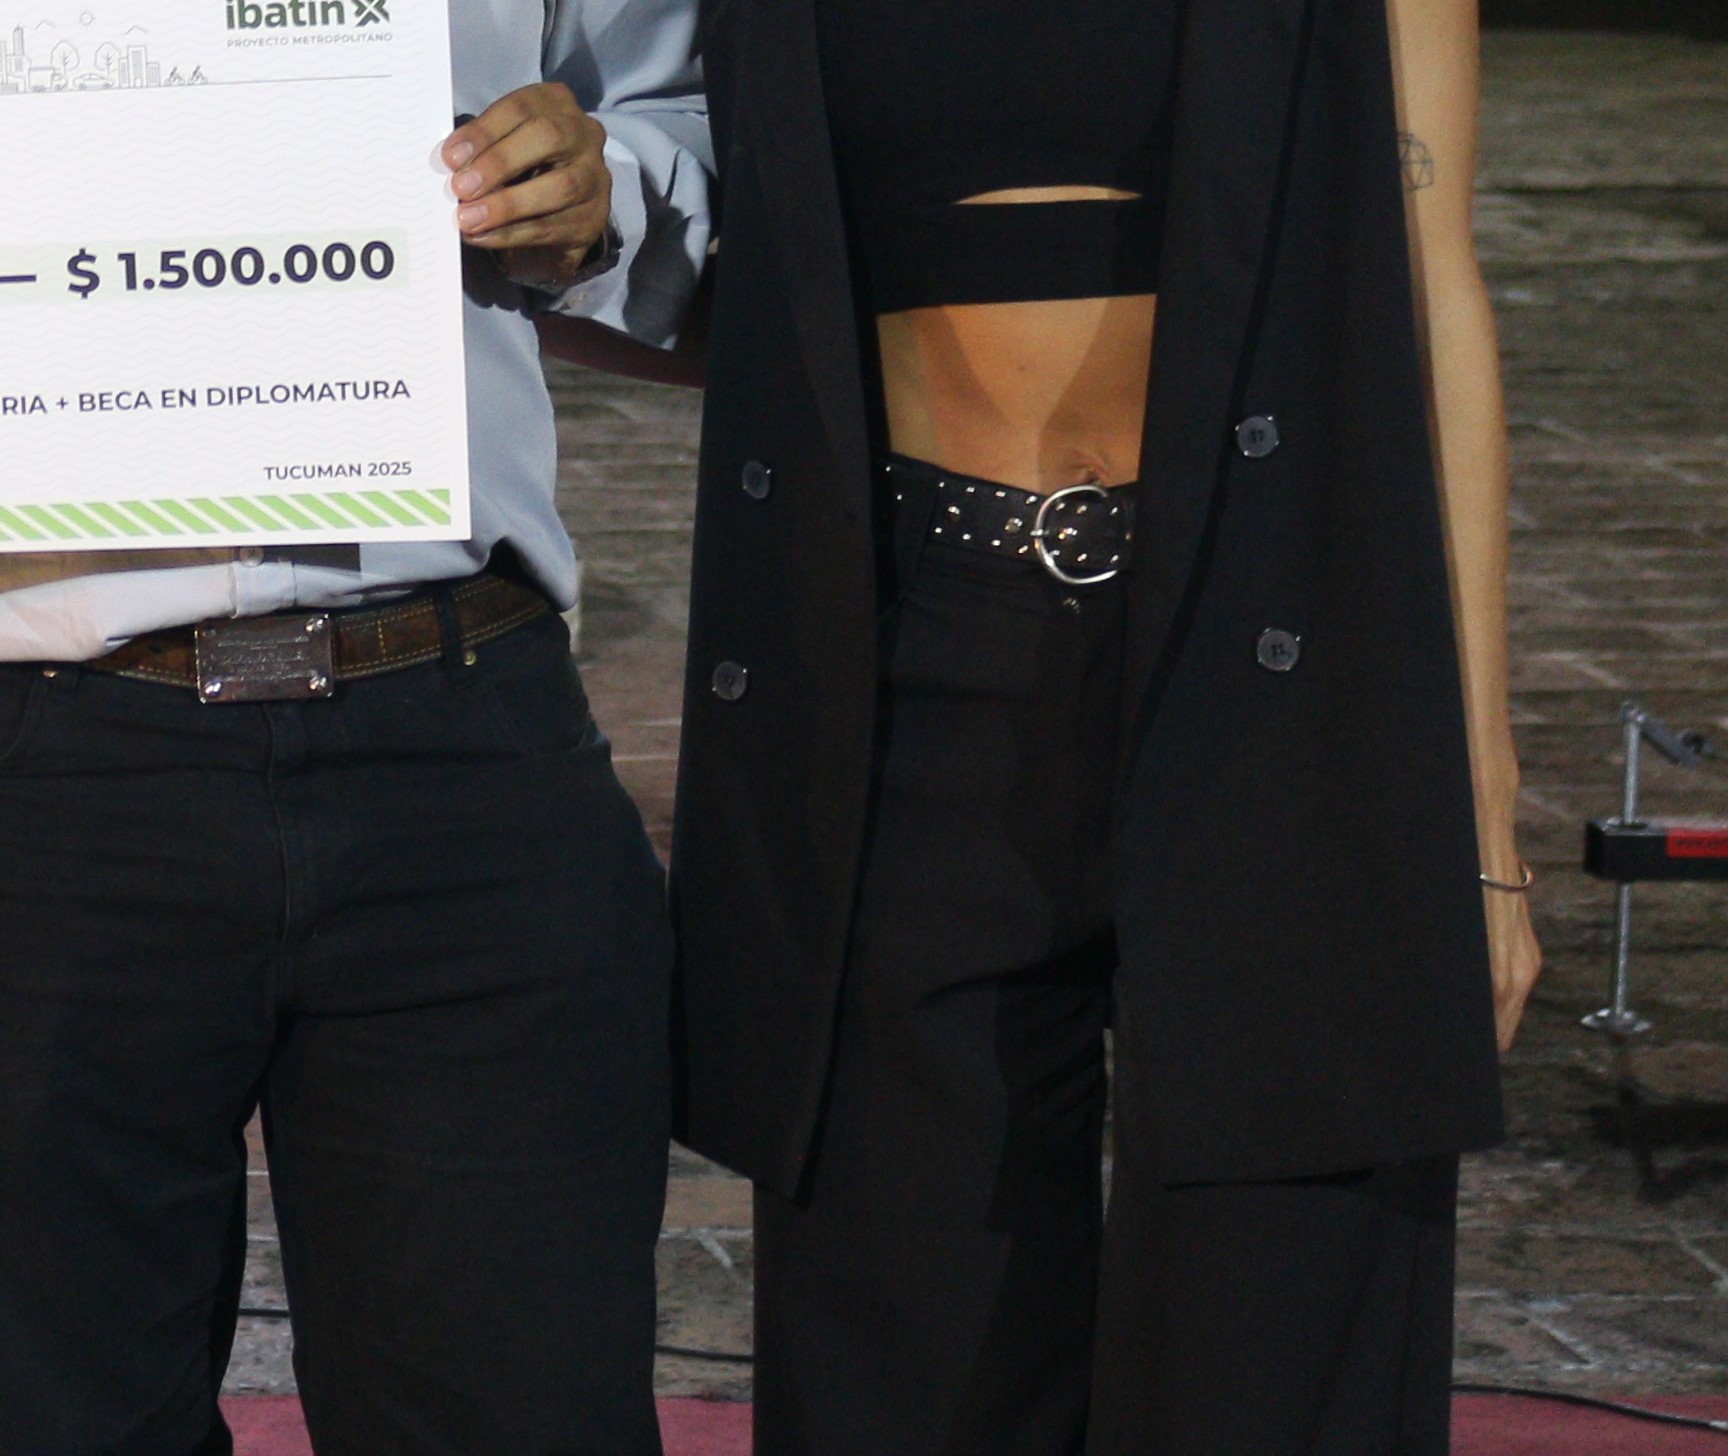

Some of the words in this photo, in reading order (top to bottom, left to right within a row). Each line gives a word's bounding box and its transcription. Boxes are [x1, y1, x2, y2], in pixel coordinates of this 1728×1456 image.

[227, 36, 289, 48] PROYECTO
[293, 32, 393, 45] METROPOLITANO
[67, 248, 101, 300] $
[117, 240, 395, 292] 1.500.000
[56, 397, 69, 410] +
[79, 391, 152, 413] BECA
[161, 389, 197, 408] EN
[207, 380, 411, 406] DIPLOMATURA
[263, 463, 362, 481] TUCUMAN
[367, 461, 413, 478] 2025
